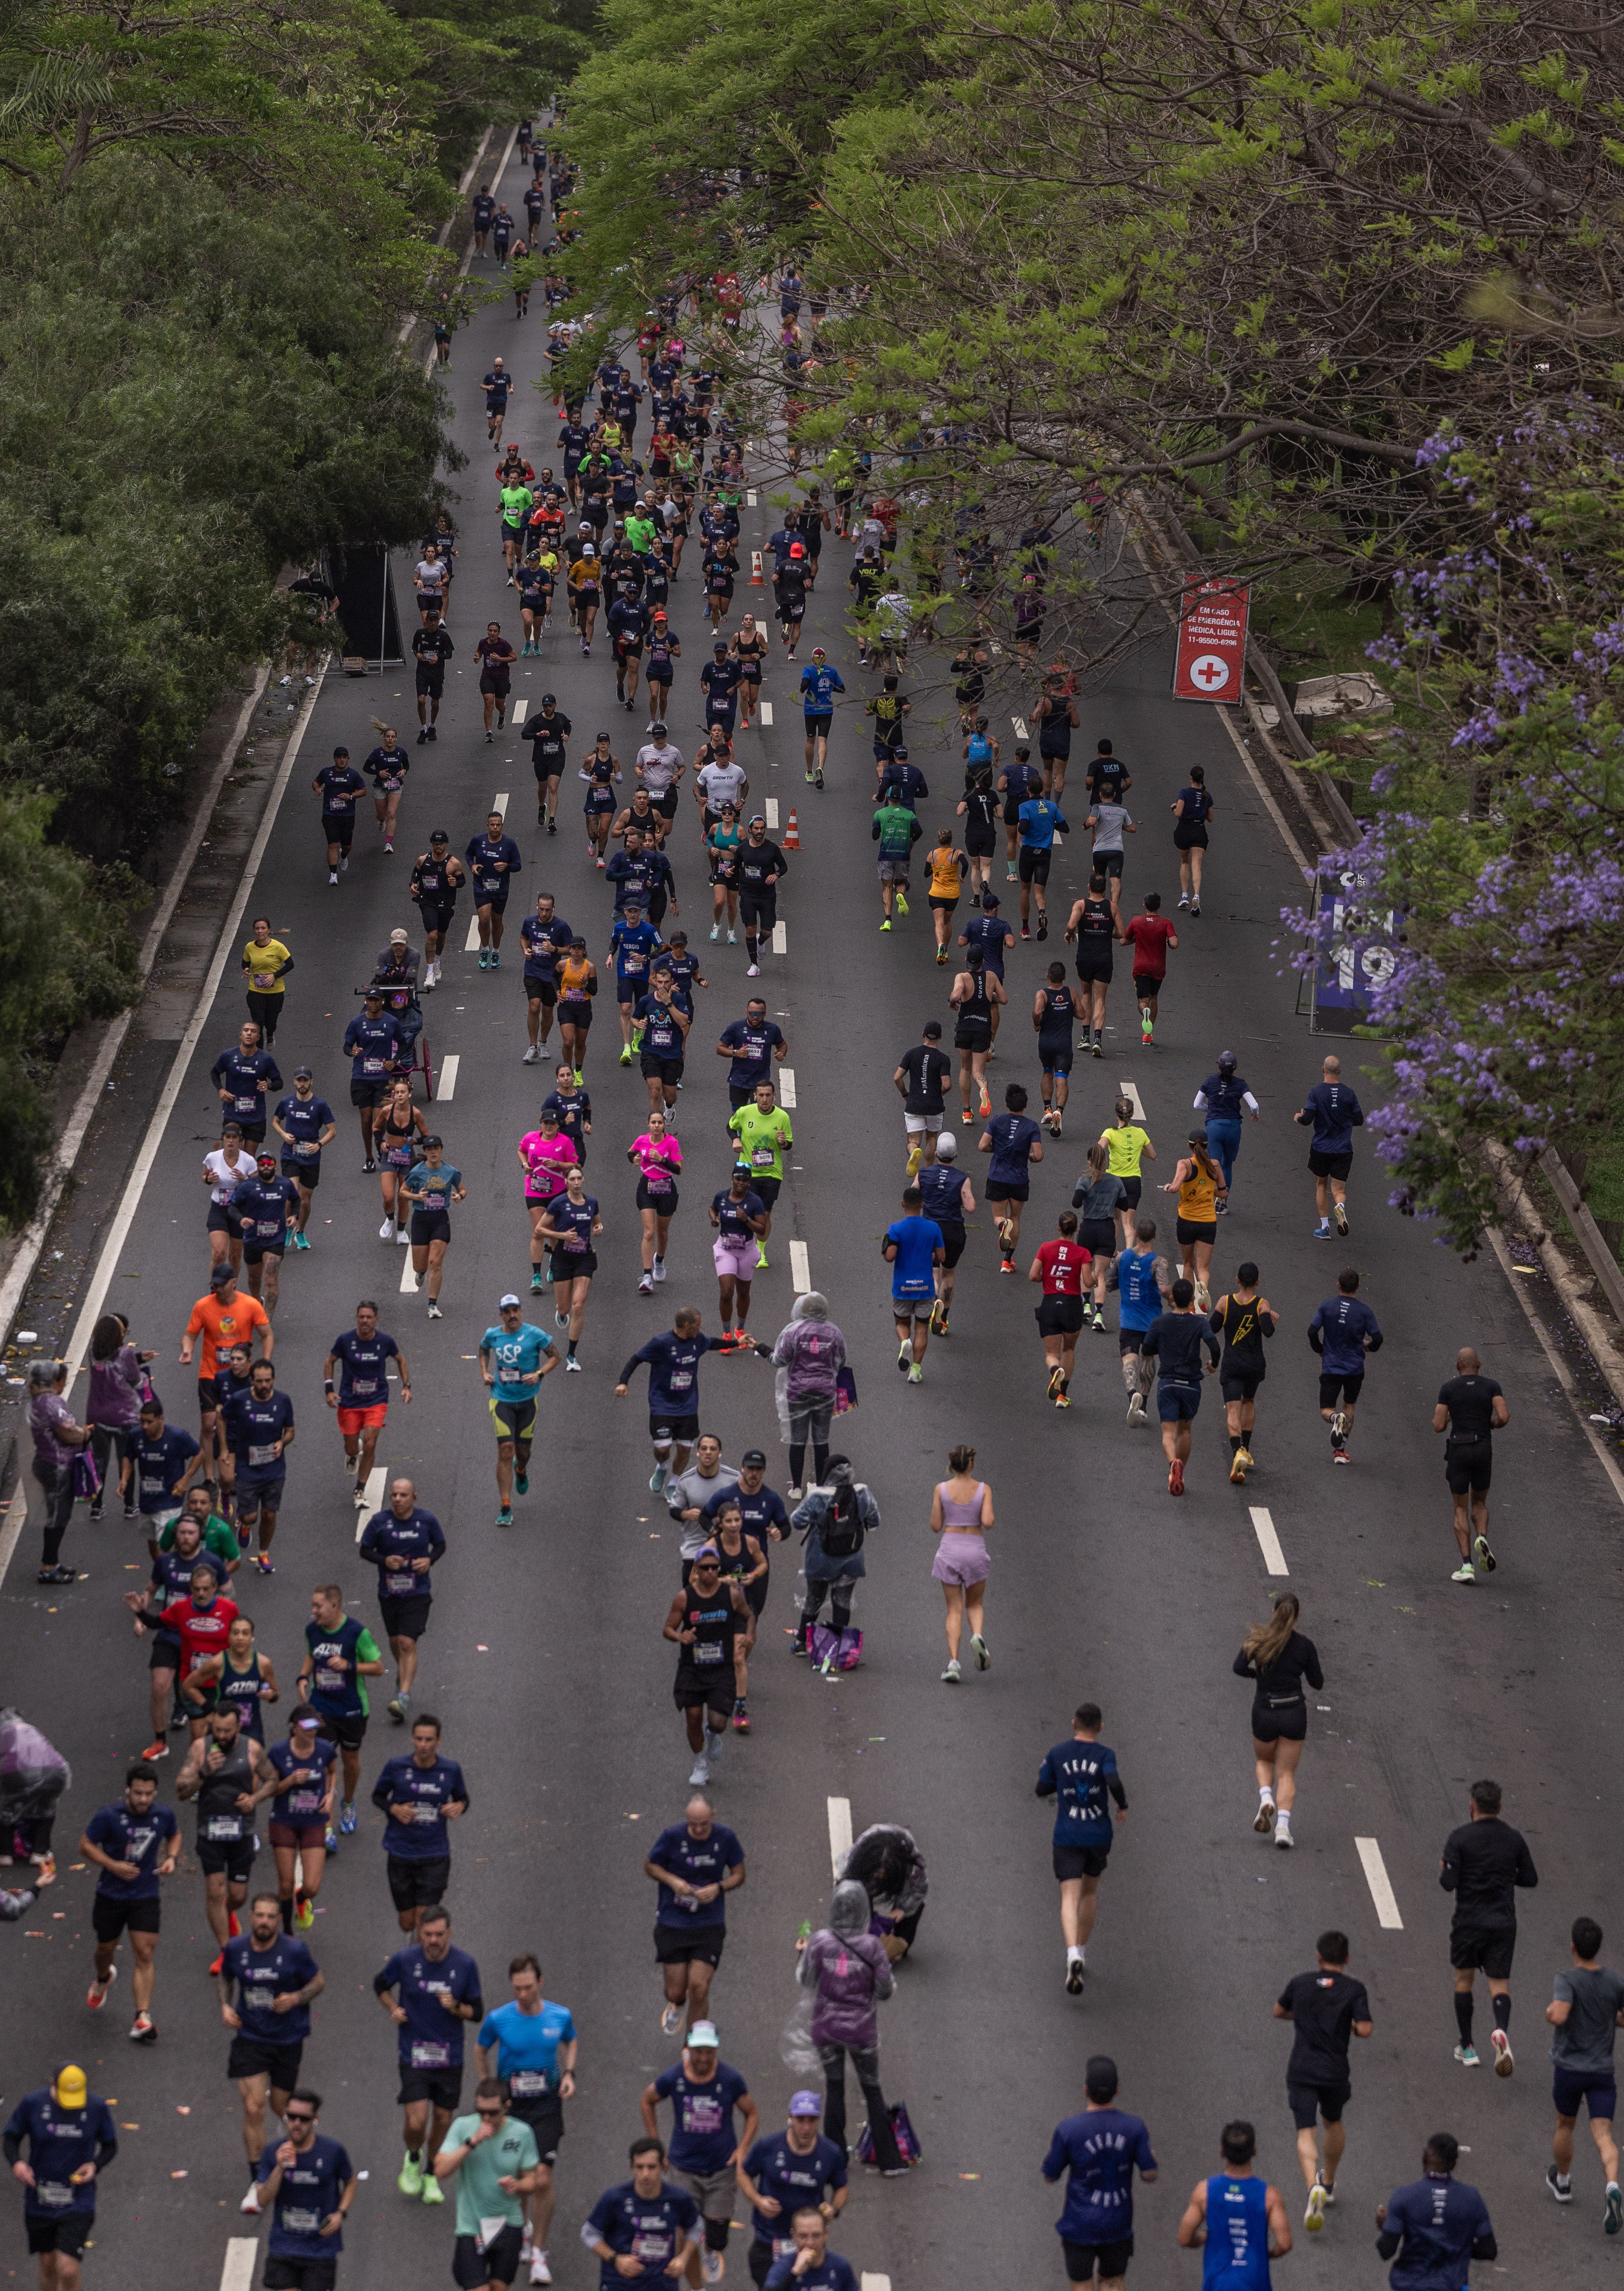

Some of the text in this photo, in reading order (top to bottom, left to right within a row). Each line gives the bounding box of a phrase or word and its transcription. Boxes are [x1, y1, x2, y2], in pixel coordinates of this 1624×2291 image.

[1198, 616, 1240, 627] EMERGÊNCIA
[1188, 625, 1238, 637] MÉDICA, LIGUE:
[1188, 636, 1237, 646] 11-95500-6296
[1329, 944, 1395, 991] 19
[649, 1015, 672, 1024] BOA
[495, 1344, 522, 1364] S&P
[1062, 1759, 1099, 1776] TEAM
